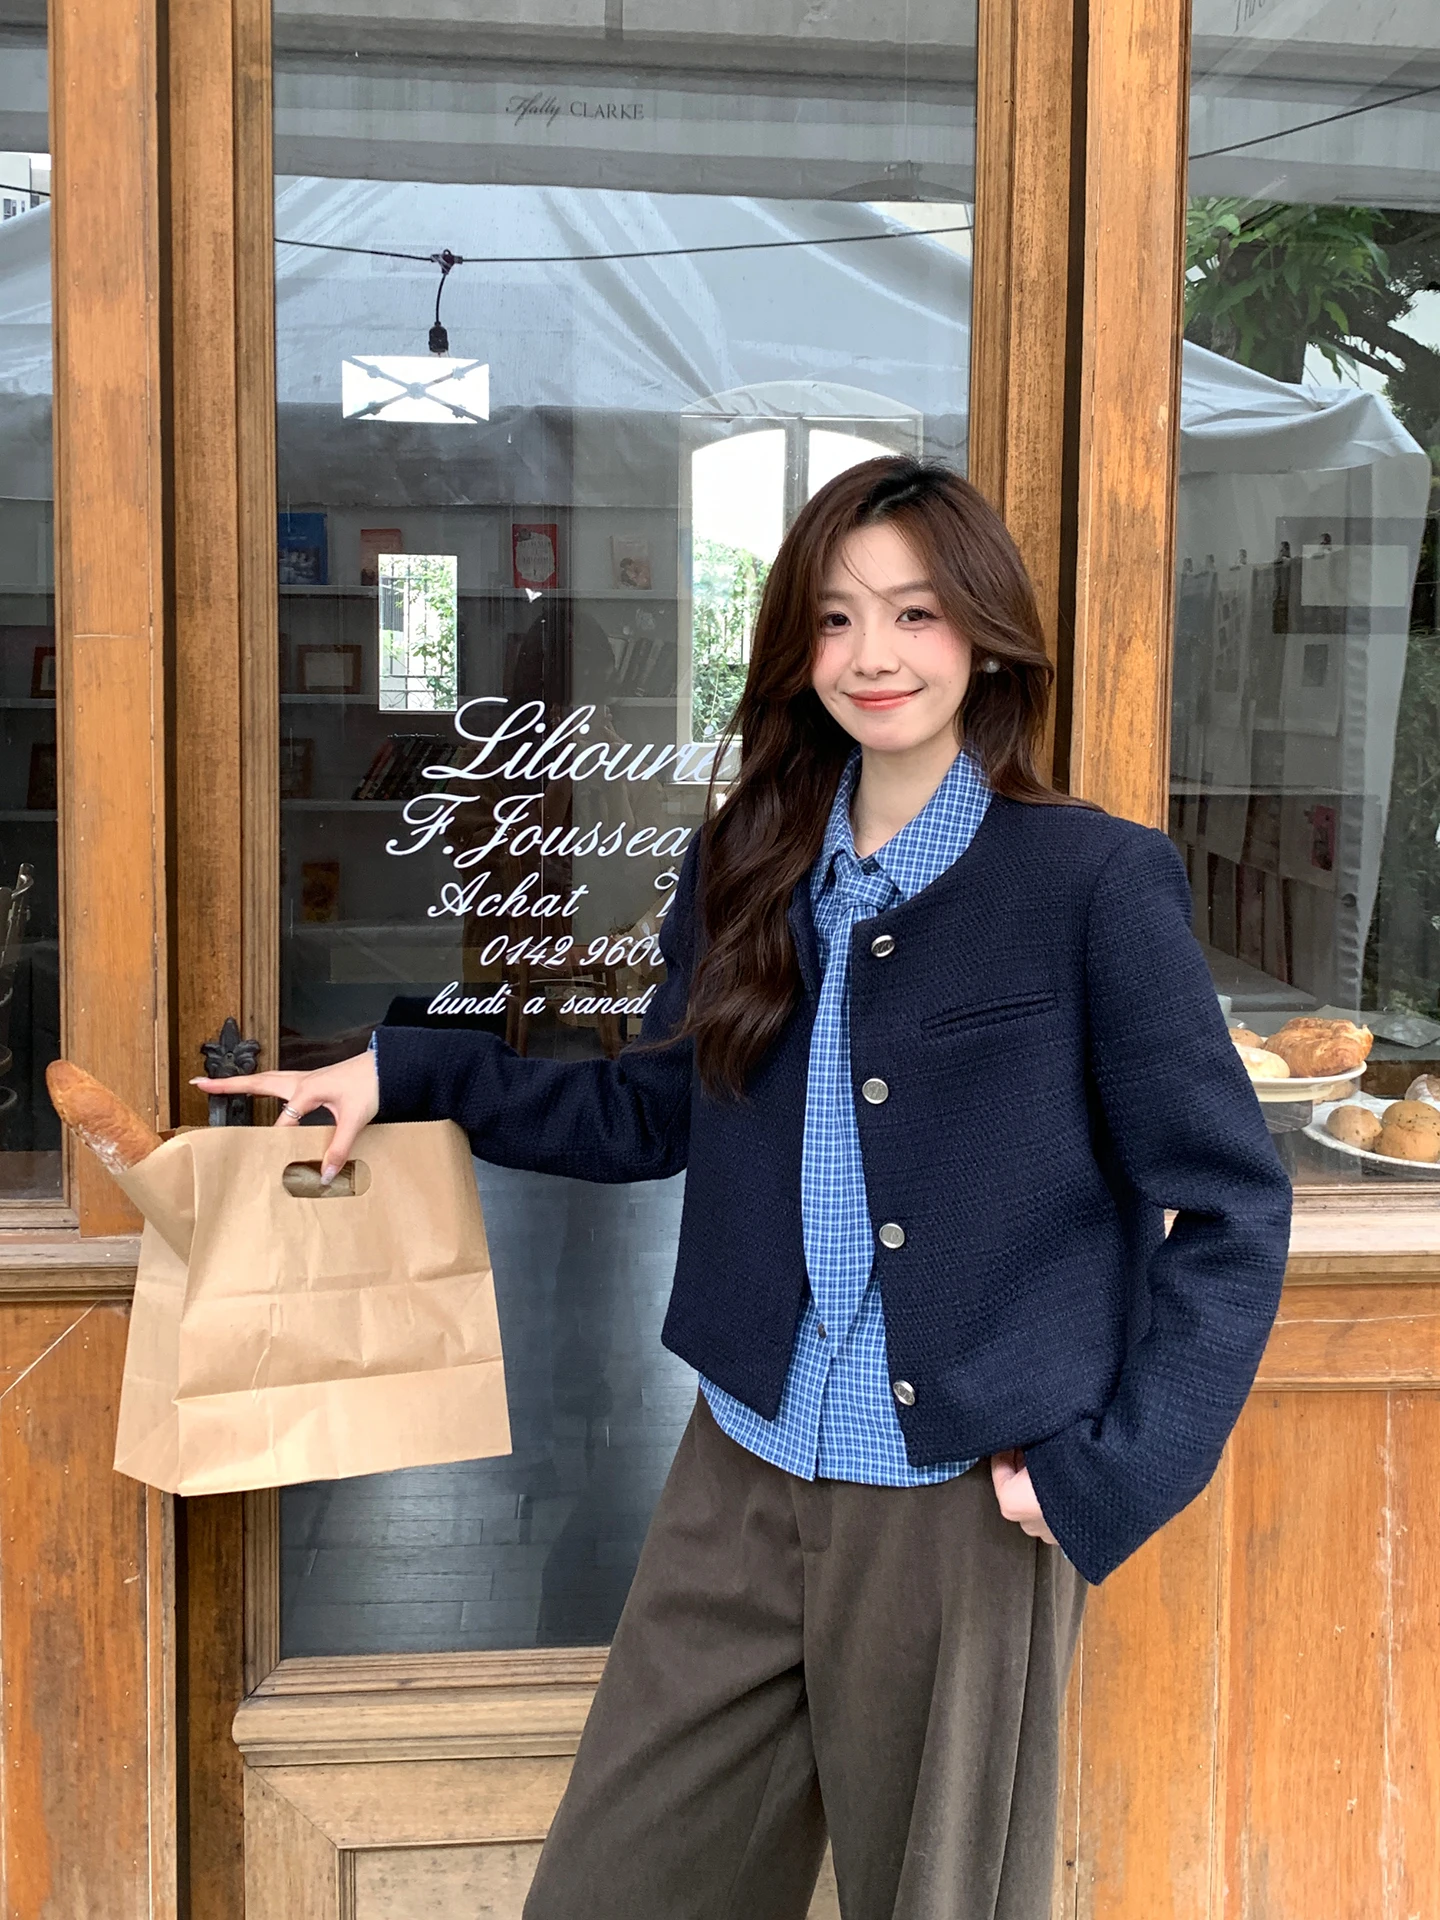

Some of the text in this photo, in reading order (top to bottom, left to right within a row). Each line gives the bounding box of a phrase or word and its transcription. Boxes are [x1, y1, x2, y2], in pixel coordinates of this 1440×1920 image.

[570, 101, 644, 120] CLARKE
[427, 872, 589, 918] Achat
[479, 935, 574, 967] 0142
[427, 981, 511, 1015] lundi
[521, 994, 547, 1014] a
